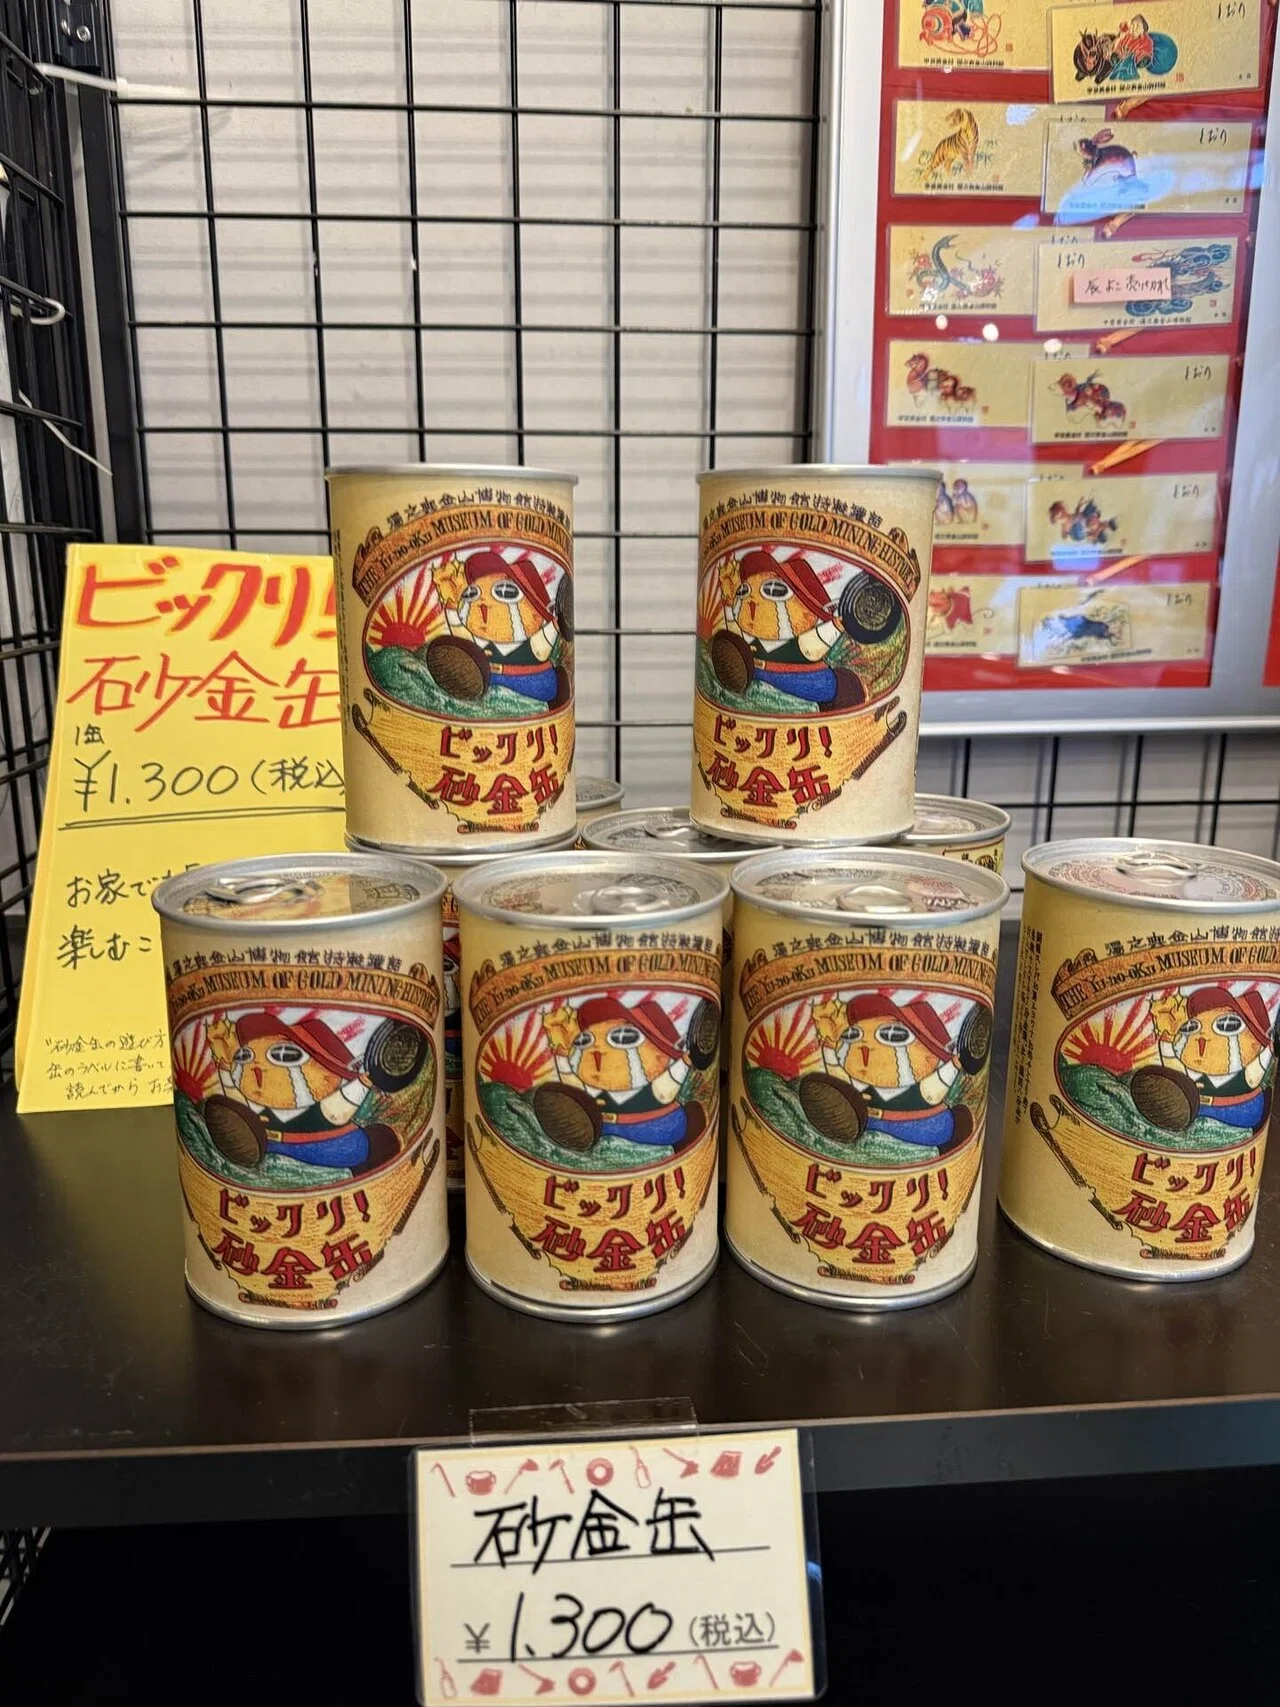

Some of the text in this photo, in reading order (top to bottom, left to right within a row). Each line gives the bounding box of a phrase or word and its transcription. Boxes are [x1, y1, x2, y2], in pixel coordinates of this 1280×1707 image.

[431, 510, 492, 538] MUSEUM
[497, 511, 513, 528] OF
[516, 512, 544, 533] GOLD
[720, 510, 766, 537] MUSEUM
[771, 511, 787, 529] OF
[790, 510, 828, 534] GOLD
[829, 517, 881, 555] MINING
[66, 650, 342, 733] 砂金缶
[440, 723, 560, 766] ビックリ!
[713, 713, 833, 760] ビックリ!
[427, 764, 564, 816] 砂金缶
[706, 750, 832, 807] 砂金缶
[205, 972, 267, 996] MUSEUM
[273, 972, 292, 989] OF
[297, 971, 344, 990] GOLD
[345, 973, 402, 999] MINING
[542, 954, 611, 982] MUSEUM
[617, 955, 636, 973] OF
[639, 953, 675, 972] GOLD
[814, 953, 884, 976] MUSEUM
[889, 953, 909, 971] OF
[911, 953, 949, 973] GOLD
[1059, 988, 1088, 1010] THE
[1156, 947, 1226, 972] MUSEUM
[1230, 946, 1248, 964] OF
[1249, 945, 1277, 964] GOLD
[544, 1166, 686, 1220] ビックリ!
[805, 1163, 949, 1213] ビックリ!
[1131, 1146, 1257, 1195] ビックリ!
[219, 1188, 370, 1239] ビックリ!
[789, 1202, 948, 1264] 砂金缶
[1112, 1187, 1252, 1243] 砂金缶
[213, 1228, 373, 1290] 砂金缶
[529, 1209, 686, 1273] 砂金缶
[474, 1487, 715, 1574] 砂金缶
